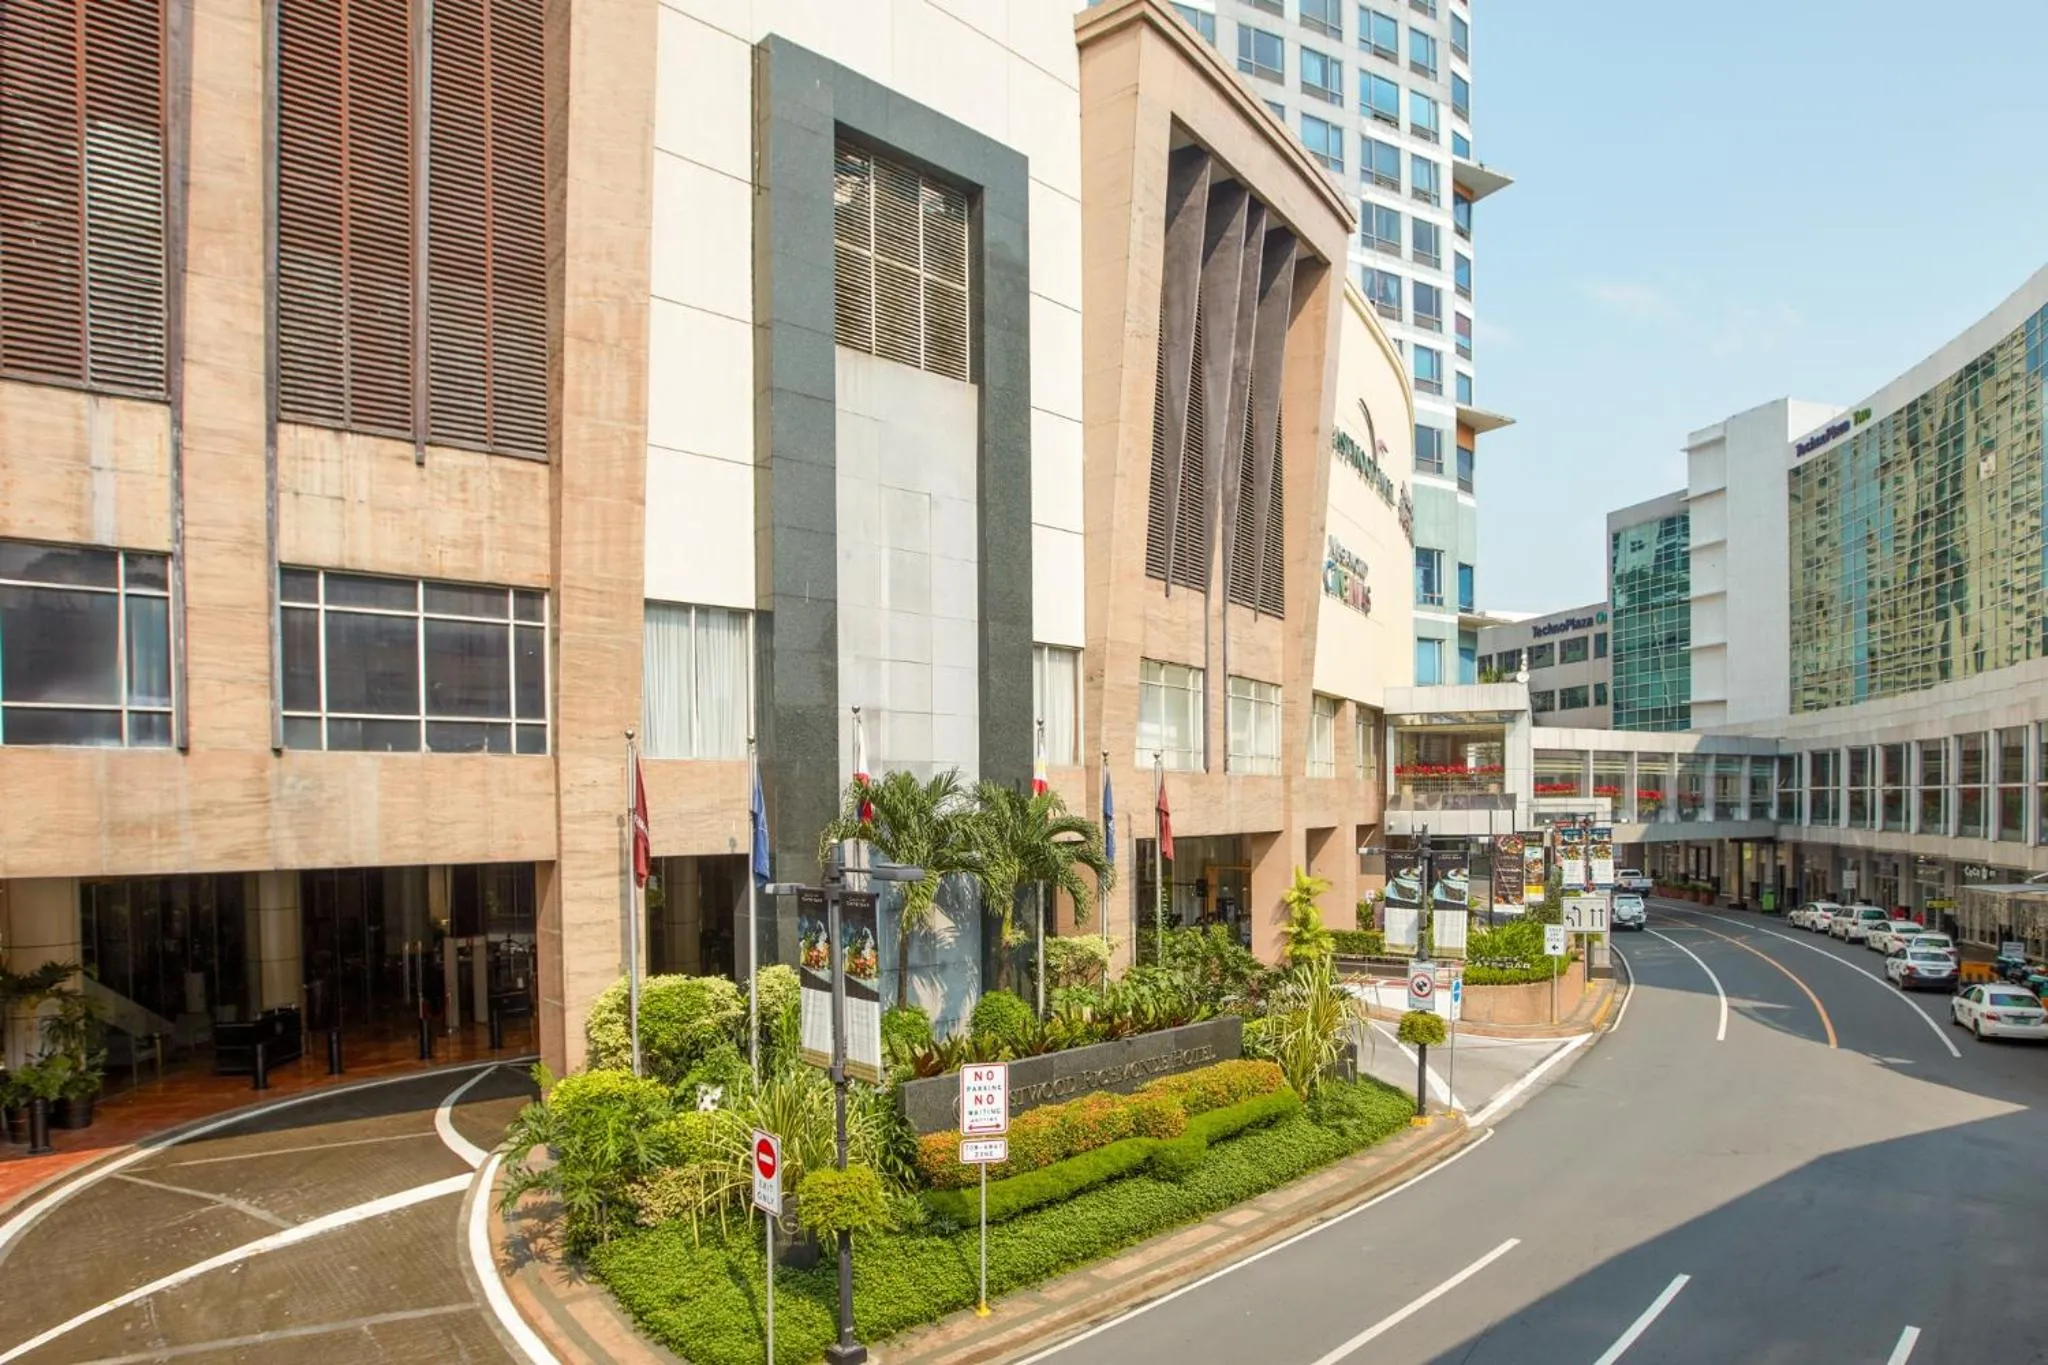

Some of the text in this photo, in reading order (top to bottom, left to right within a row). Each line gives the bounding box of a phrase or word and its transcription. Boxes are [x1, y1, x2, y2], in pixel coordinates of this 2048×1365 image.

[1532, 617, 1594, 639] TechnoPlaza
[1172, 1044, 1217, 1069] HOTEL
[974, 1070, 995, 1082] NO
[966, 1084, 1002, 1093] PARKING
[974, 1094, 995, 1106] NO
[968, 1107, 1001, 1116] WAITING
